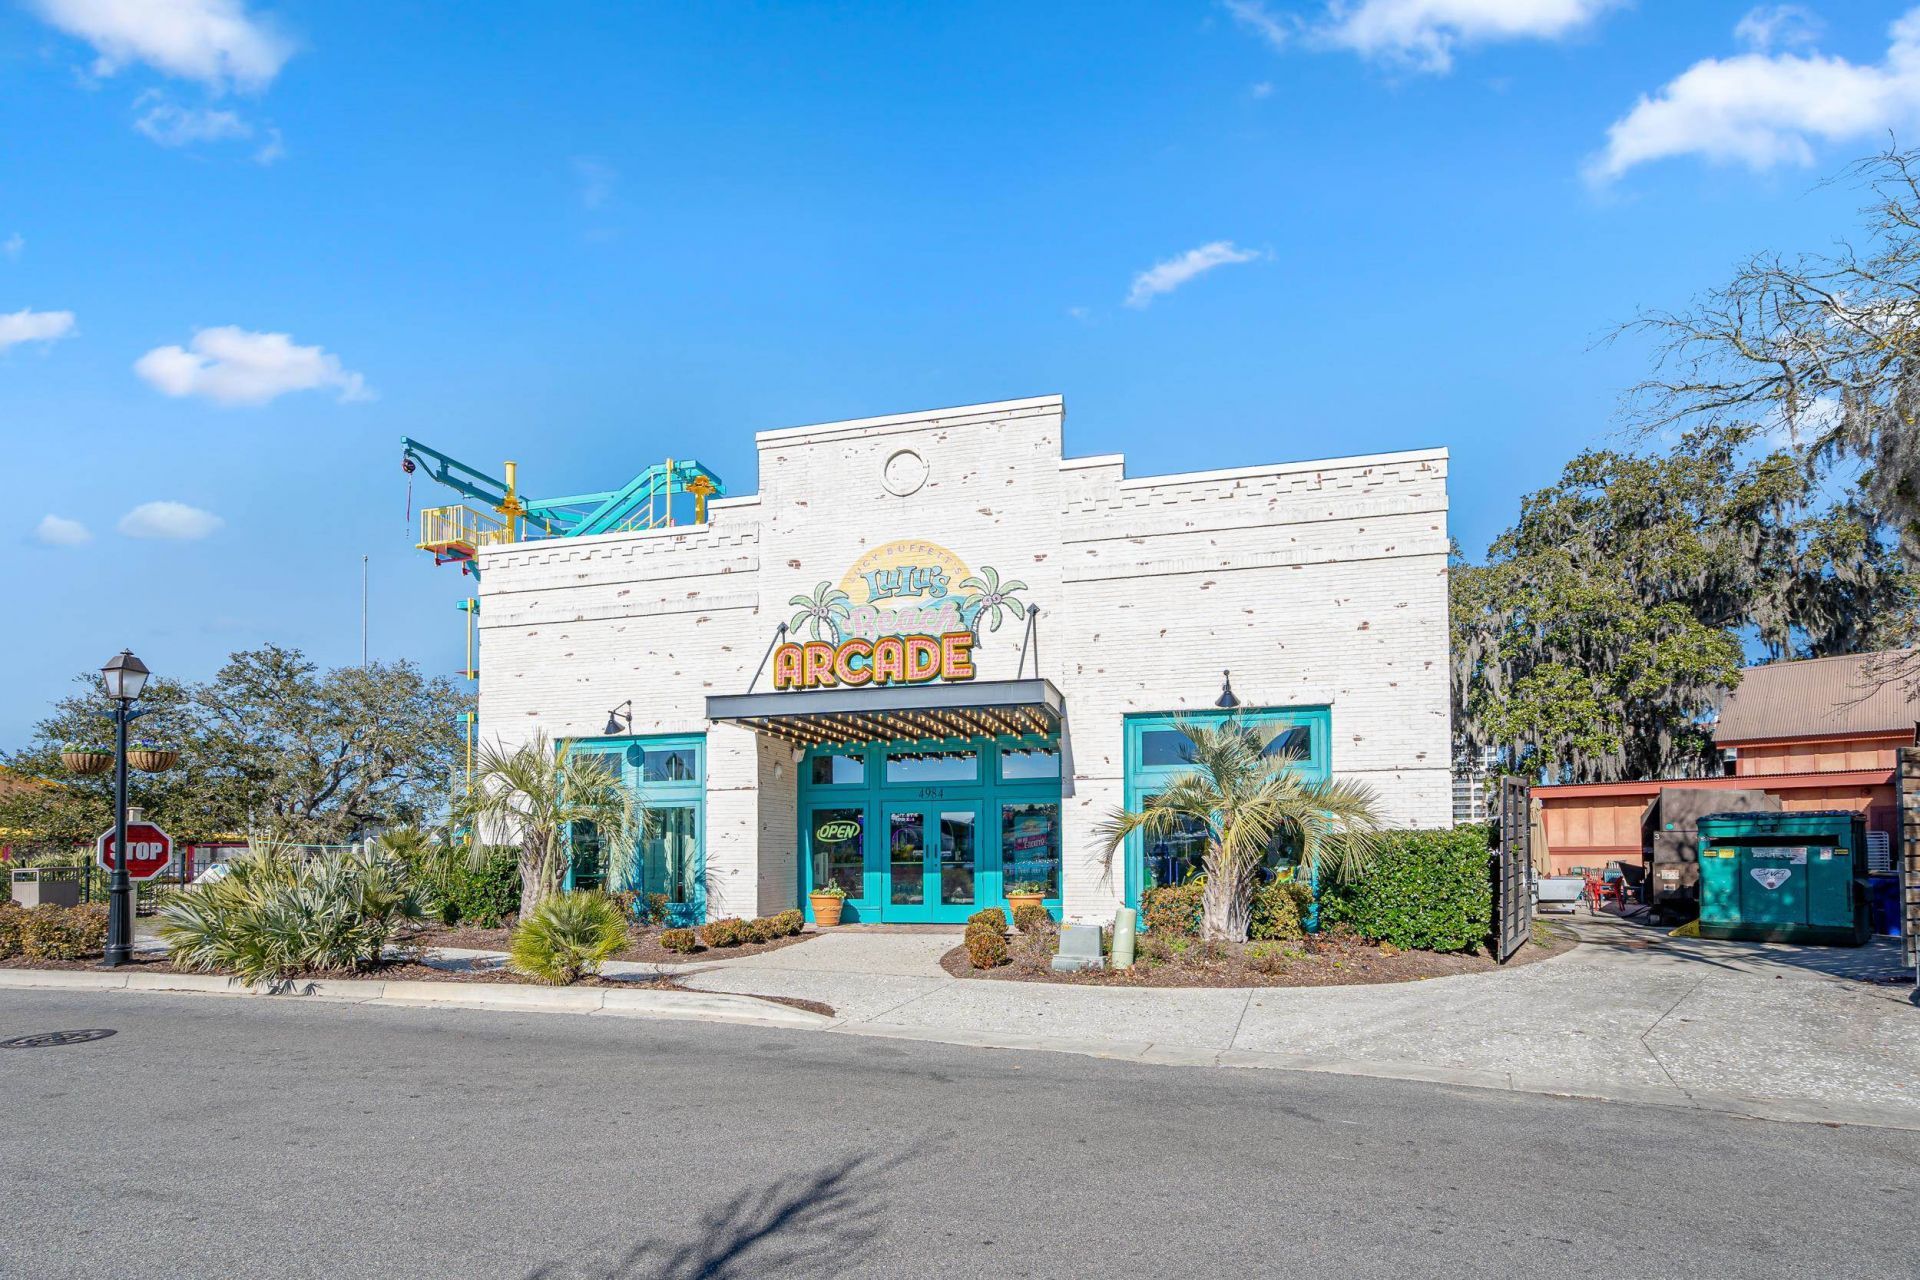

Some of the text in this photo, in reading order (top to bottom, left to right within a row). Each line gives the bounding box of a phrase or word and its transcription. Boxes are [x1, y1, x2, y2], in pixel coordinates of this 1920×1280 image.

[886, 543, 963, 576] BUFFETT'S
[841, 601, 967, 641] Beach
[774, 631, 977, 691] ARCADE
[918, 787, 944, 800] 4984
[819, 824, 856, 839] OPEN
